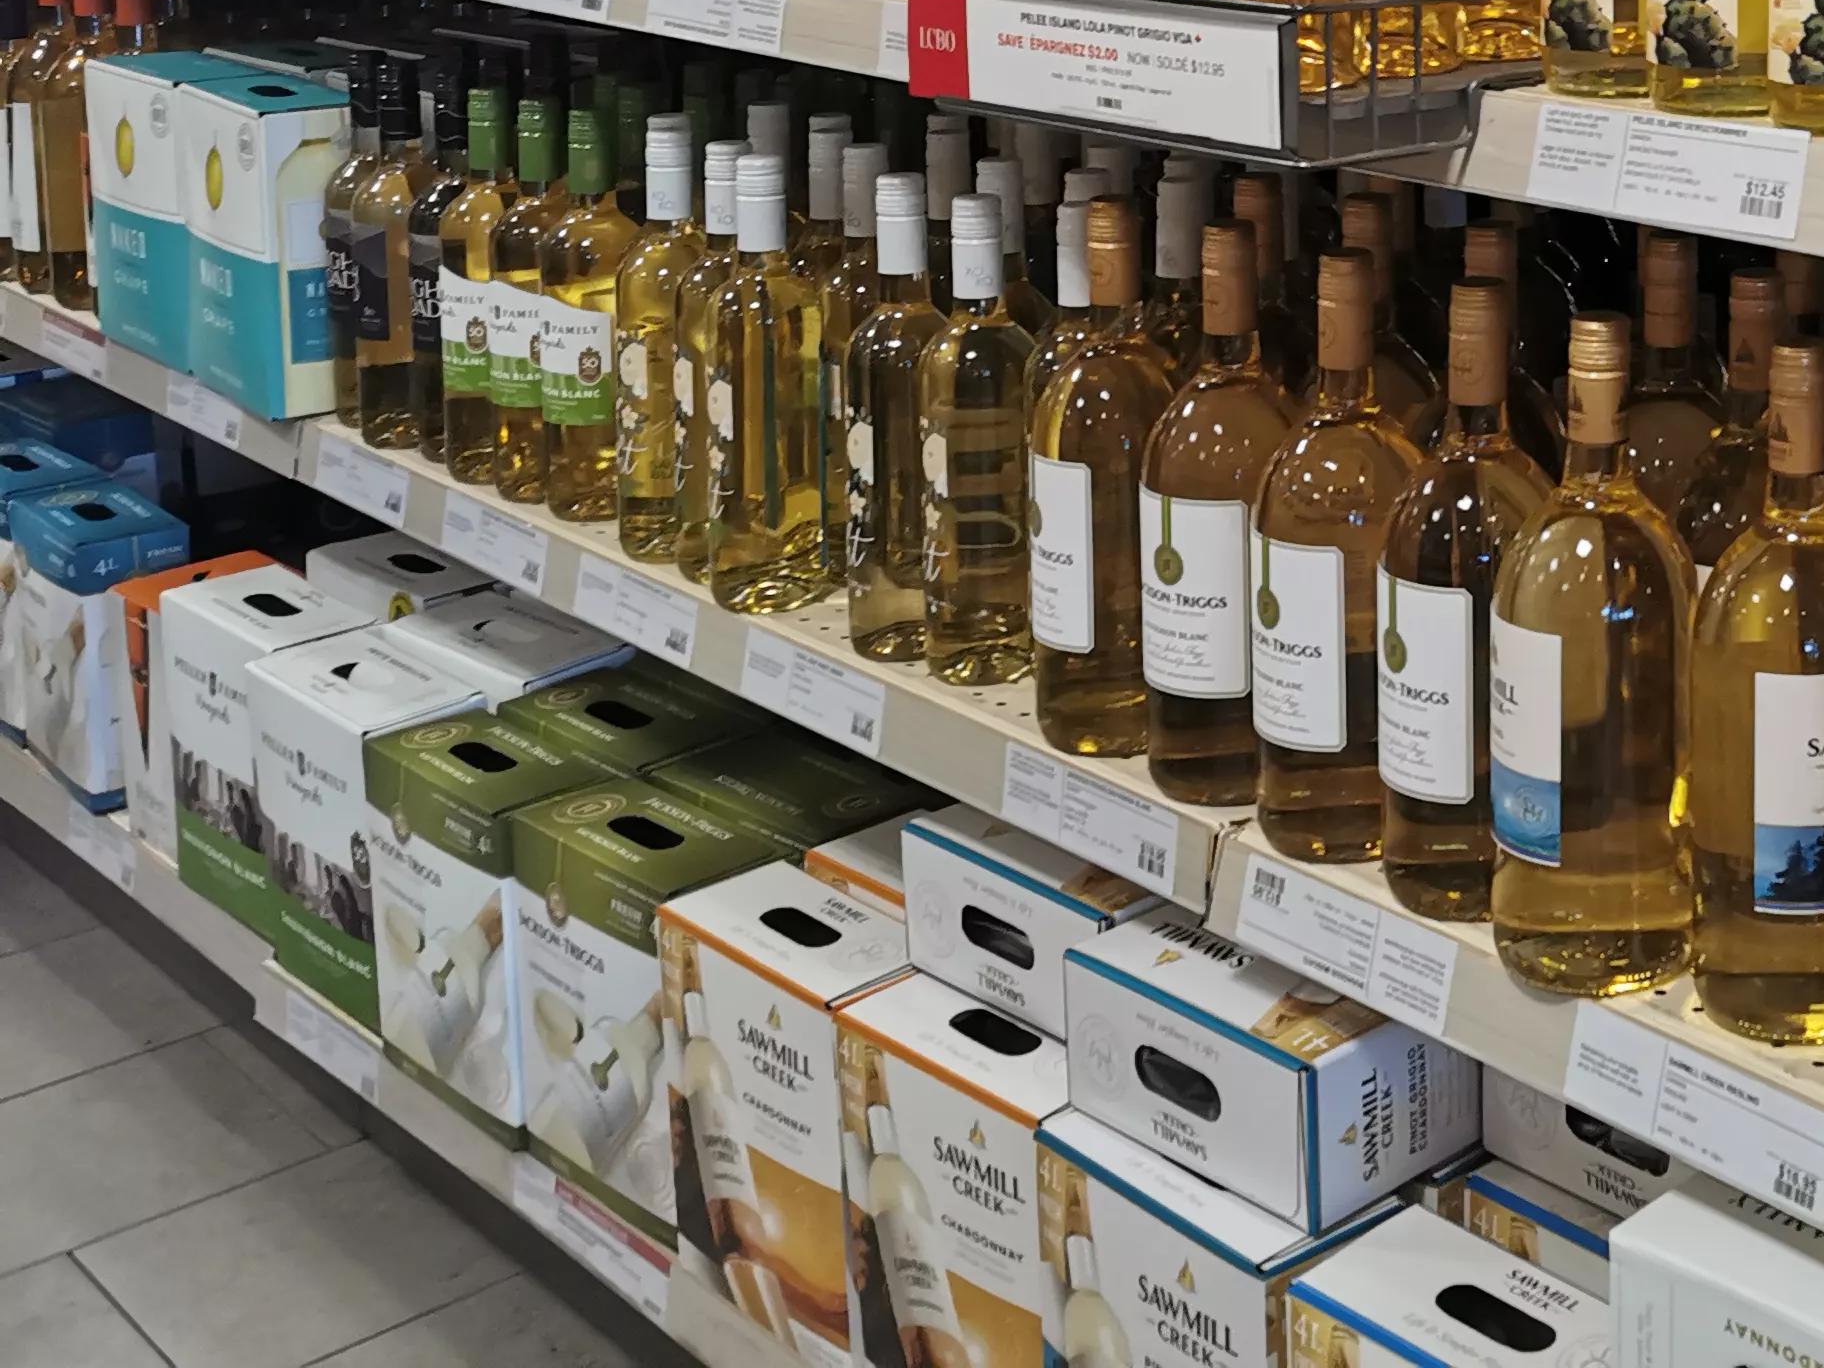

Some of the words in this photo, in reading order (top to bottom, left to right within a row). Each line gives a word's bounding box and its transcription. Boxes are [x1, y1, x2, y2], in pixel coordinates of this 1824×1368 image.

[919, 26, 955, 53] LCBO
[1049, 15, 1081, 30] ISLAND
[1083, 18, 1105, 32] LOLA
[997, 33, 1024, 49] SAVE
[1030, 33, 1086, 58] ÉPARGNEZ
[1127, 52, 1150, 65] NOW
[1157, 53, 1189, 72] SOLDÉ
[1191, 59, 1225, 77] $12.95
[1745, 182, 1786, 199] $12.45
[560, 389, 600, 398] BLANC
[737, 1019, 815, 1081] SAWMILL
[839, 1037, 864, 1068] 4L
[752, 1053, 799, 1093] CREEK
[1408, 1046, 1418, 1101] GRIGIO
[741, 1091, 812, 1137] CHARDONNAY
[1381, 1085, 1394, 1149] CREEK
[1416, 1043, 1427, 1152] CHARDONNAY
[1363, 1068, 1378, 1182] SAWMILL
[1409, 1112, 1418, 1155] PINOT
[933, 1136, 1026, 1204] SAWMILL
[1039, 1162, 1063, 1194] 4L
[952, 1174, 1006, 1216] CREEK
[941, 1213, 1024, 1263] CHARDONNAY
[1471, 1211, 1500, 1239] 4L
[1505, 1267, 1580, 1314] SAWMILL
[1137, 1274, 1241, 1359] SAWMILL
[1295, 1313, 1324, 1347] 4L
[1156, 1317, 1219, 1368] CREEK
